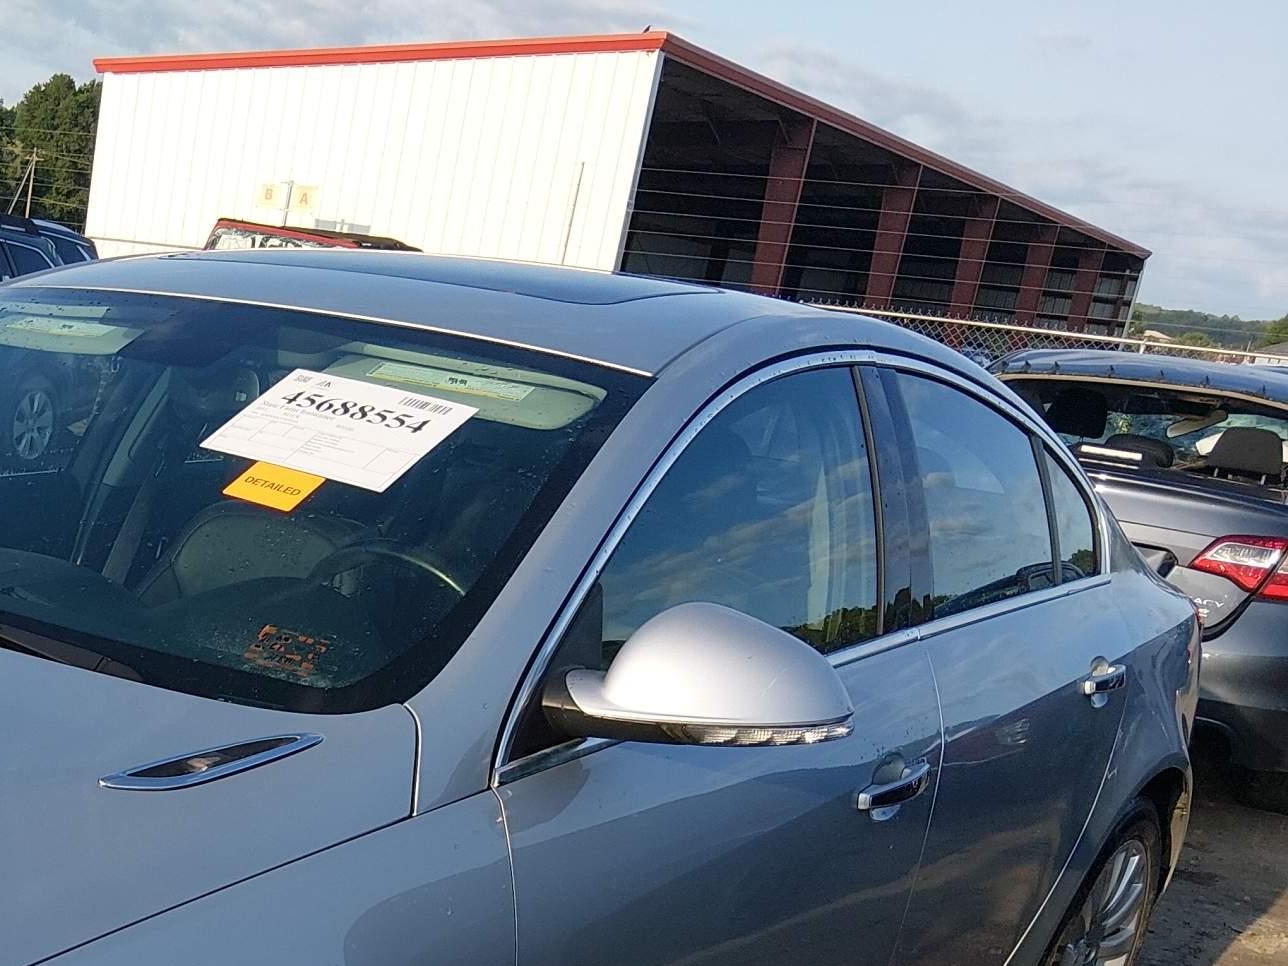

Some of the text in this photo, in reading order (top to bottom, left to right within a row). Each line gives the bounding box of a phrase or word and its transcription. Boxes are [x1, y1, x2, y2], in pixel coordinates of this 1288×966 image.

[264, 188, 273, 200] B
[299, 192, 309, 205] A
[280, 390, 432, 434] 45688554
[244, 475, 302, 498] DETAILED
